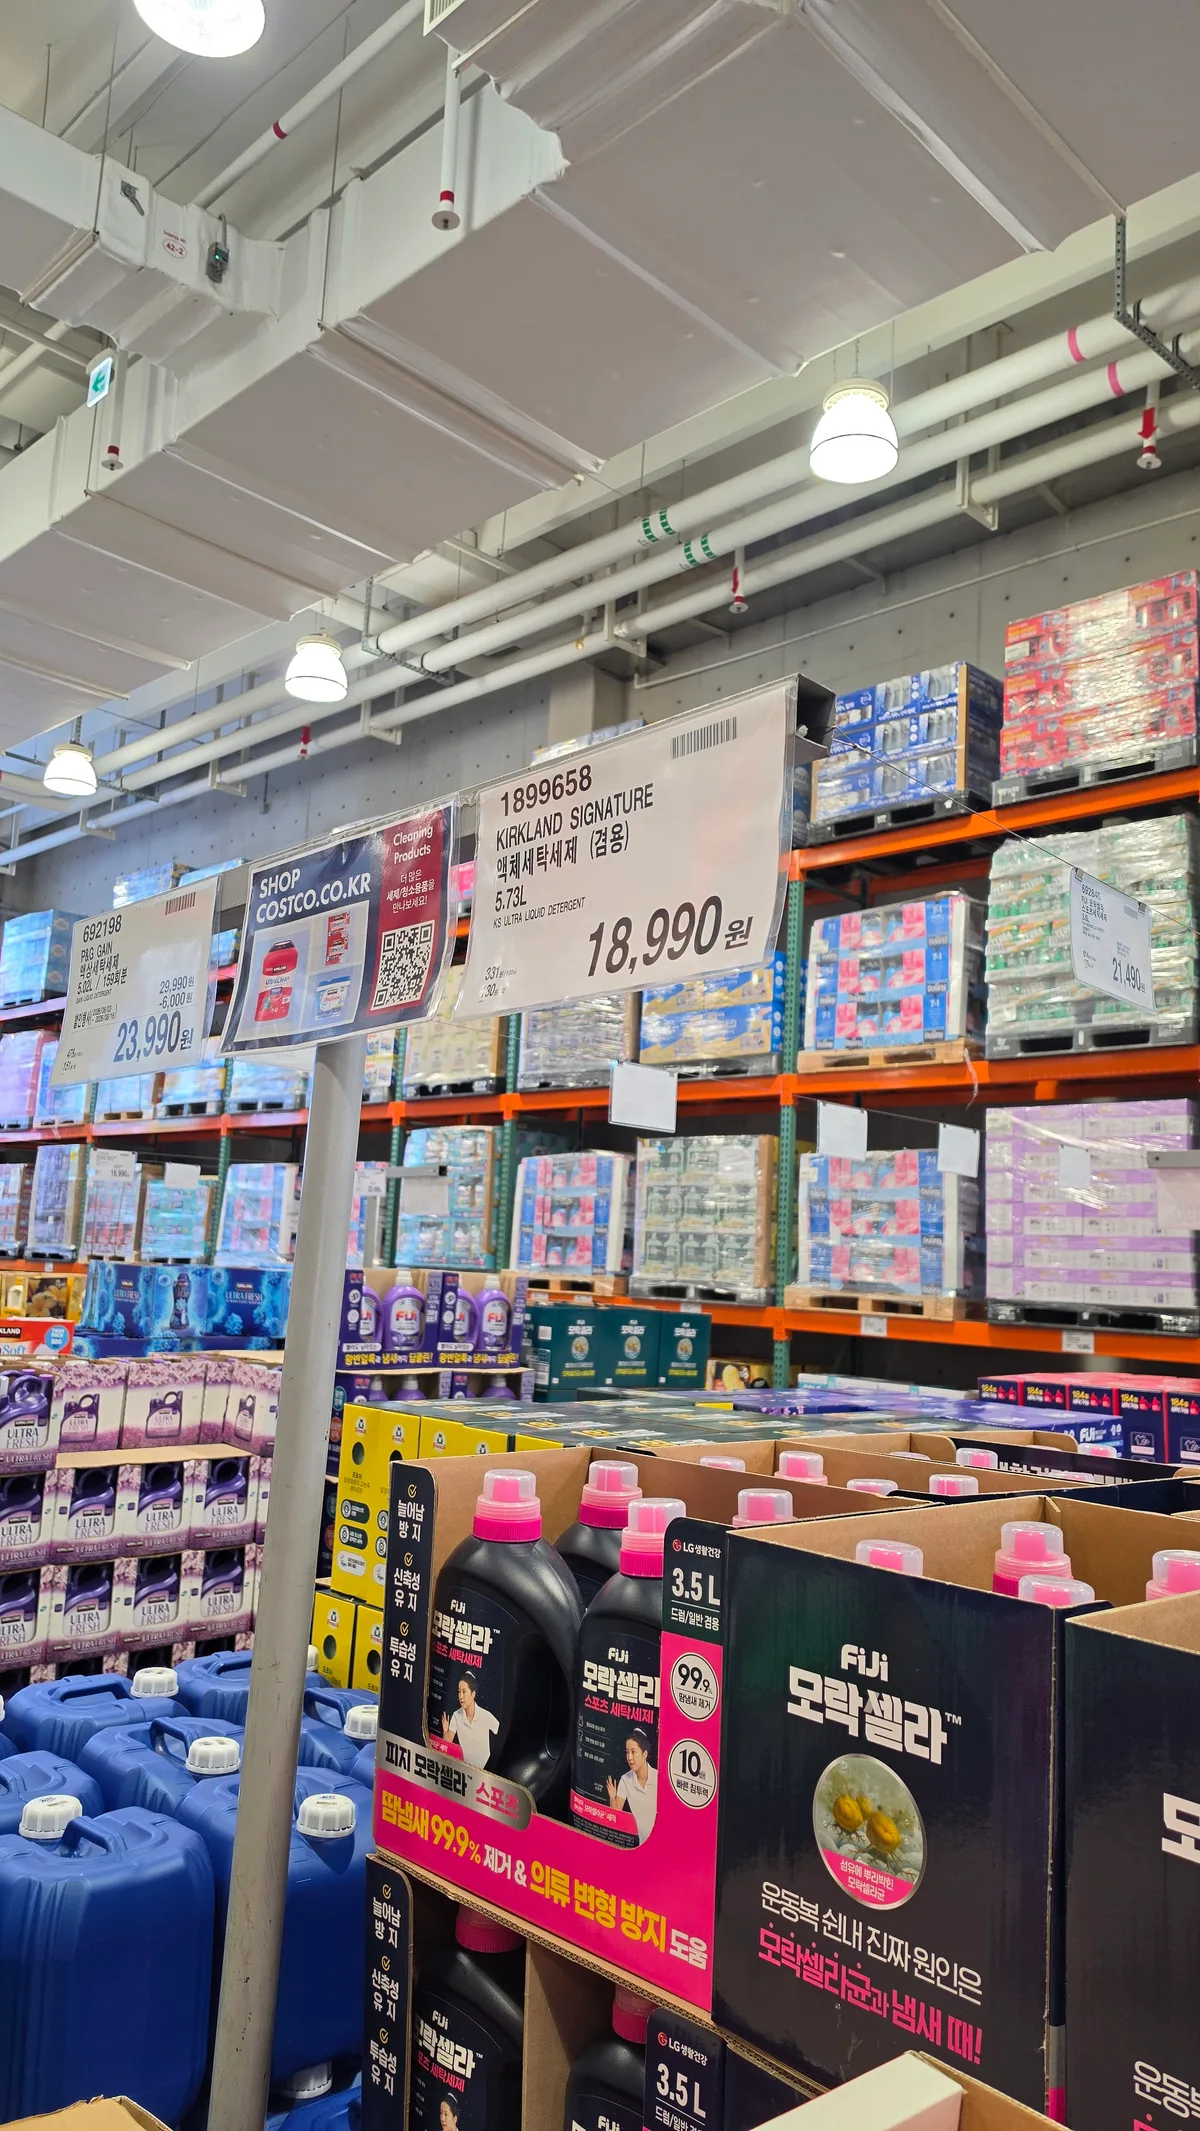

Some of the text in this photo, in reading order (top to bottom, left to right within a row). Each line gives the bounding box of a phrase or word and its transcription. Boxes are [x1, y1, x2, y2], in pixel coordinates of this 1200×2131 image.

[501, 765, 592, 816] 1899658
[497, 783, 653, 851] KIRKLAND SIGNATURE
[393, 826, 433, 846] Cleaning
[394, 845, 431, 864] Products
[497, 820, 629, 883] 액체세탁세제 (겸용)
[259, 868, 300, 898] SHOP
[400, 869, 422, 884] 더 많은
[256, 872, 371, 923] COSTCO.CO.KR
[392, 896, 428, 913] 만나보세요!
[495, 885, 527, 912] 5.73L
[493, 897, 585, 929] KS ULTRA LIQUID DETERGENT
[83, 915, 122, 943] 692198
[81, 941, 113, 963] P&G GAIN
[6, 1437, 39, 1449] FRESH
[7, 1427, 39, 1439] ULTRA
[146, 1511, 175, 1522] ULTRA
[211, 1506, 239, 1517] ULTRA
[398, 1499, 425, 1522] 늘어남
[1, 1524, 33, 1536] ULTRA
[74, 1527, 105, 1539] FRESH
[75, 1517, 106, 1529] ULTRA
[145, 1521, 174, 1531] FRESH
[393, 1567, 420, 1592] 신축성
[141, 1603, 170, 1615] ULTRA
[207, 1594, 235, 1606] ULTRA
[69, 1612, 100, 1624] ULTRA
[69, 1622, 100, 1634] FRESH
[141, 1613, 170, 1626] FRESH
[671, 1607, 719, 1631] 드럼/일반 겸용
[389, 1636, 417, 1662] 투습성
[449, 1648, 482, 1669] 세탁세제
[584, 1694, 654, 1724] 스포츠 세탁세제
[678, 1692, 711, 1710] 땀냄새 제거
[385, 1740, 410, 1772] 피지
[476, 1781, 519, 1819] 스포츠
[676, 1778, 709, 1798] 빠른 침투력
[840, 1859, 894, 1890] 섬유에 뿌리박힌
[431, 1814, 481, 1865] 99.9%
[483, 1844, 511, 1880] 제거
[514, 1859, 527, 1887] &
[530, 1860, 570, 1908] 의류
[574, 1878, 616, 1929] 변형
[621, 1899, 666, 1952] 방지
[669, 1928, 708, 1971] 도움
[848, 1876, 885, 1901] 모락셀라균
[372, 1897, 401, 1928] 늘어남
[761, 1881, 983, 2006] 운동복 쉰내 진짜 원인은
[371, 1968, 399, 2001] 신축성
[758, 1926, 983, 2065] 모락셀라균과 냄새 때!
[370, 2039, 397, 2075] 투습성
[430, 2063, 465, 2093] 세탁세제
